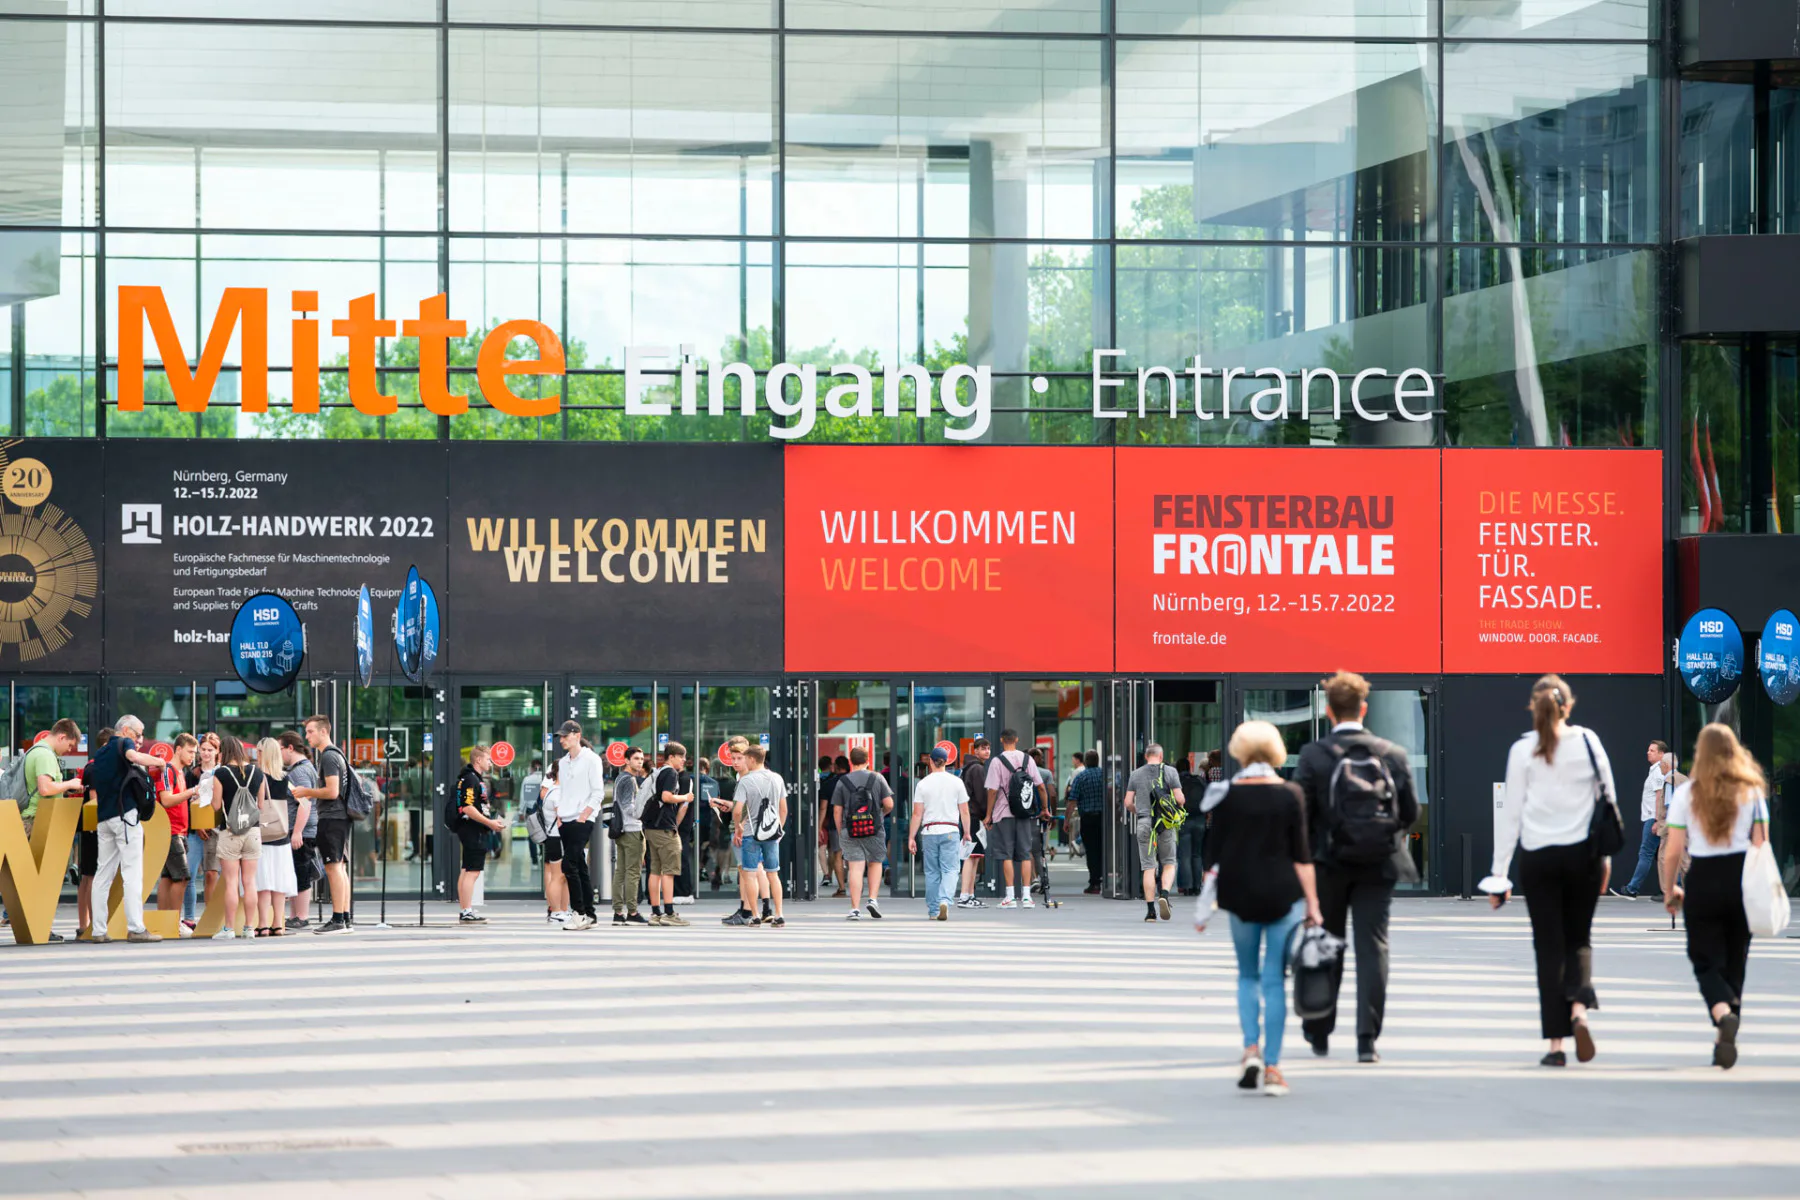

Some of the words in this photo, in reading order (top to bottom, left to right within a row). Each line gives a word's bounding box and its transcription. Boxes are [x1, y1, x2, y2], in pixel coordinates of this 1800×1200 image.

[117, 285, 566, 417] Mitte
[623, 343, 992, 440] Eingang
[1092, 348, 1436, 421] Entrance
[173, 470, 231, 485] Nürnberg,
[235, 470, 288, 485] Germany
[173, 487, 258, 499] 12.–15.7.2022
[1479, 491, 1521, 515] DIE
[1532, 491, 1624, 515] MESSE.
[1153, 494, 1394, 530] FENSTERBAU
[173, 516, 374, 536] HOLZ-HANDWERK
[380, 516, 434, 538] 2022
[820, 510, 1075, 545] WILLKOMMEN
[1479, 522, 1598, 546] FENSTER.
[466, 517, 766, 553] WILLKOMMEN
[173, 553, 226, 564] Europäische
[228, 553, 276, 563] Fachmesse
[278, 553, 290, 563] für
[292, 553, 390, 565] Maschinentechnologie
[1153, 533, 1395, 576] FRONTALE
[503, 547, 729, 583] WELCOME
[1477, 548, 1535, 577] TÜR.
[173, 567, 191, 576] und
[193, 566, 268, 578] Fertigungsbedarf
[820, 557, 1002, 591] WELCOME
[173, 587, 215, 598] European
[217, 587, 242, 597] Trade
[277, 587, 315, 598] Machine
[317, 587, 361, 599] Technolog
[1479, 585, 1601, 609] FASSADE.
[173, 601, 190, 610] and
[192, 600, 229, 612] Supplies
[292, 601, 318, 611] Crafts
[1153, 593, 1250, 615] Nürnberg,
[1257, 594, 1395, 612] 12.–15.7.2022
[253, 608, 280, 621] HSD
[1479, 619, 1497, 629] THE
[1500, 619, 1530, 630] TRADE
[1700, 621, 1724, 633] HSD
[1775, 622, 1793, 636] HSD
[1153, 631, 1227, 645] frontale.de
[1479, 632, 1526, 643] WINDOW.
[1529, 633, 1560, 643] DOOR.
[1563, 633, 1602, 644] FACADE.
[240, 642, 256, 651] HALL
[240, 651, 261, 659] STAND
[261, 650, 273, 658] 215
[1686, 652, 1701, 661] HALL
[1686, 661, 1705, 670] STAND
